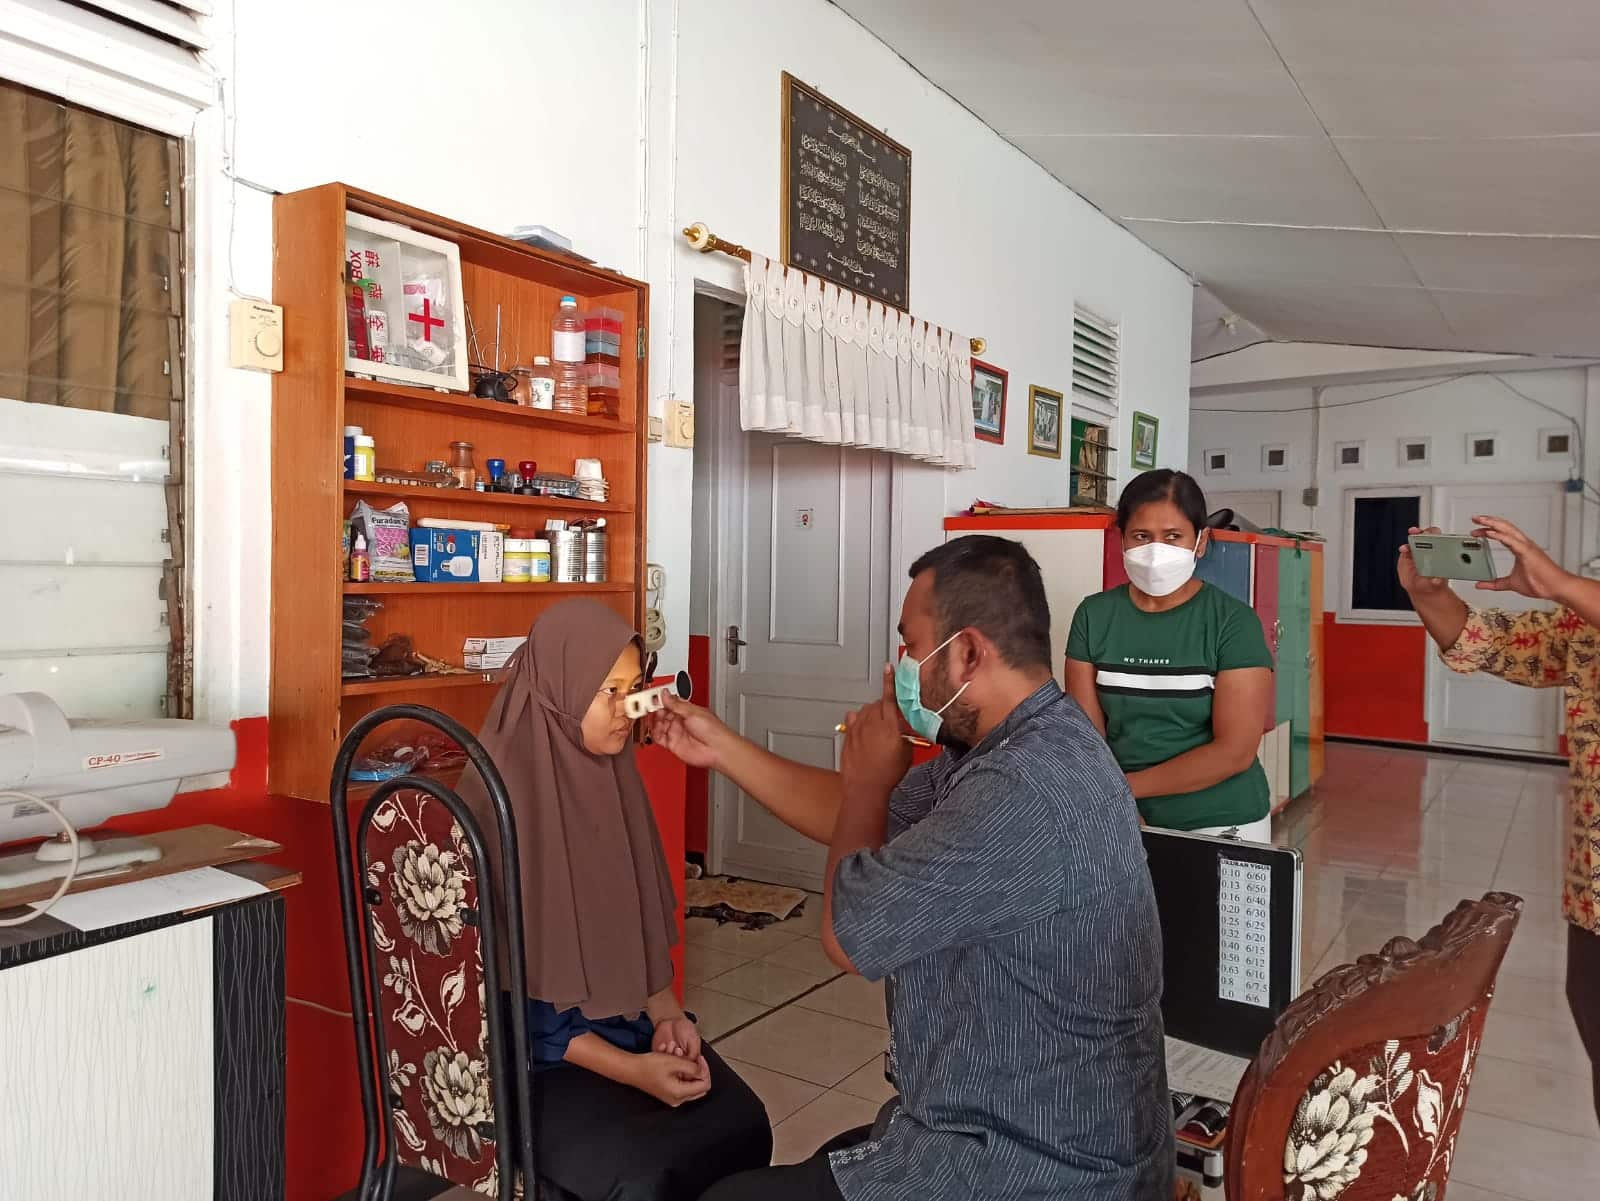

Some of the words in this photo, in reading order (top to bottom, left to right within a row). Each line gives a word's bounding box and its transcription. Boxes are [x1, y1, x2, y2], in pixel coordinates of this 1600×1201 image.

[1123, 656, 1135, 664] NO
[88, 754, 121, 766] CP-40
[1246, 872, 1266, 882] 6/60
[1246, 883, 1266, 893] 6/50
[1246, 896, 1266, 906] 6/40
[1246, 908, 1266, 918] 6/30
[1246, 920, 1265, 930] 6/25
[1246, 932, 1266, 942] 6/20
[1246, 944, 1265, 955] 6/15
[1246, 956, 1265, 967] 6/12
[1246, 968, 1265, 979] 6/10
[1245, 981, 1268, 992] 6/7.5
[1245, 994, 1260, 1003] 6/6
